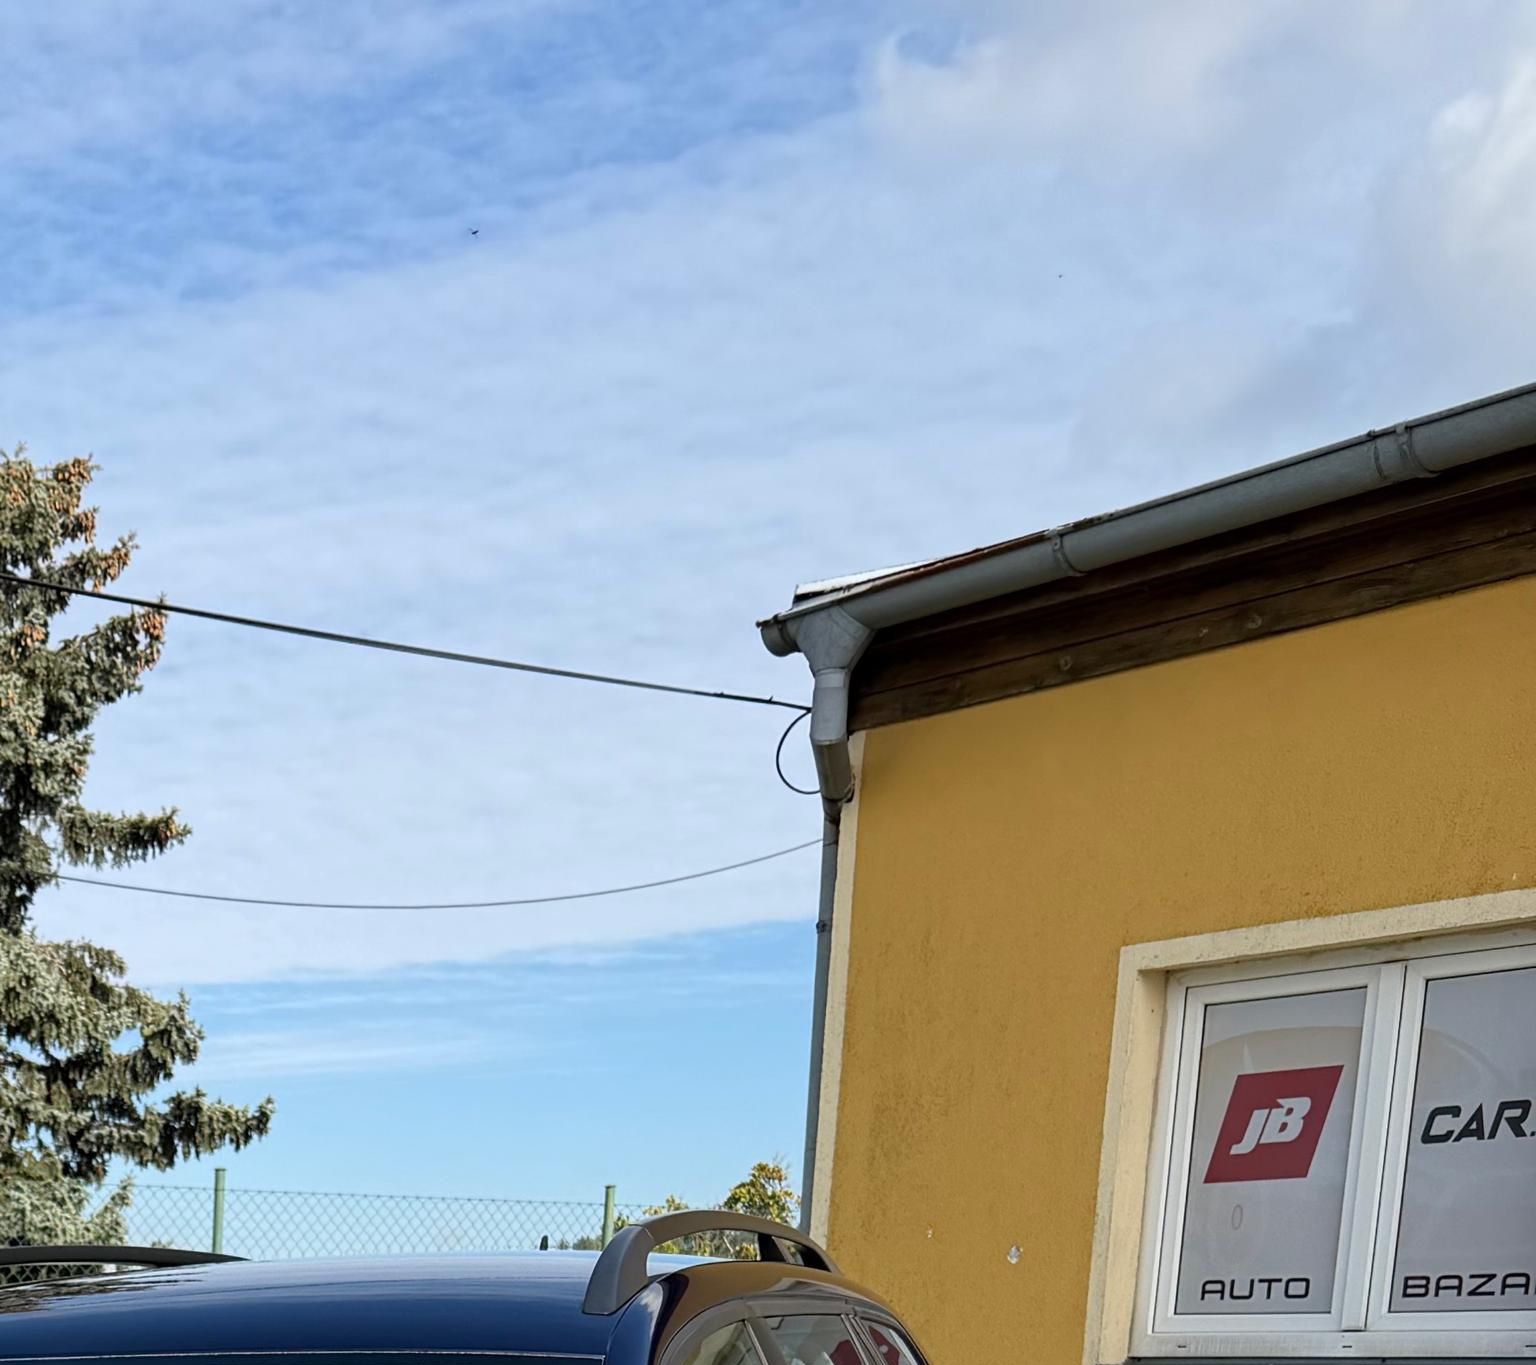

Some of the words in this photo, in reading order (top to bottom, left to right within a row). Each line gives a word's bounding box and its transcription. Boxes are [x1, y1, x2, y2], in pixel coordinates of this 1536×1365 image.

[1230, 1097, 1312, 1155] JB
[1200, 1277, 1310, 1301] AUTO
[1401, 1272, 1536, 1298] BAZA
